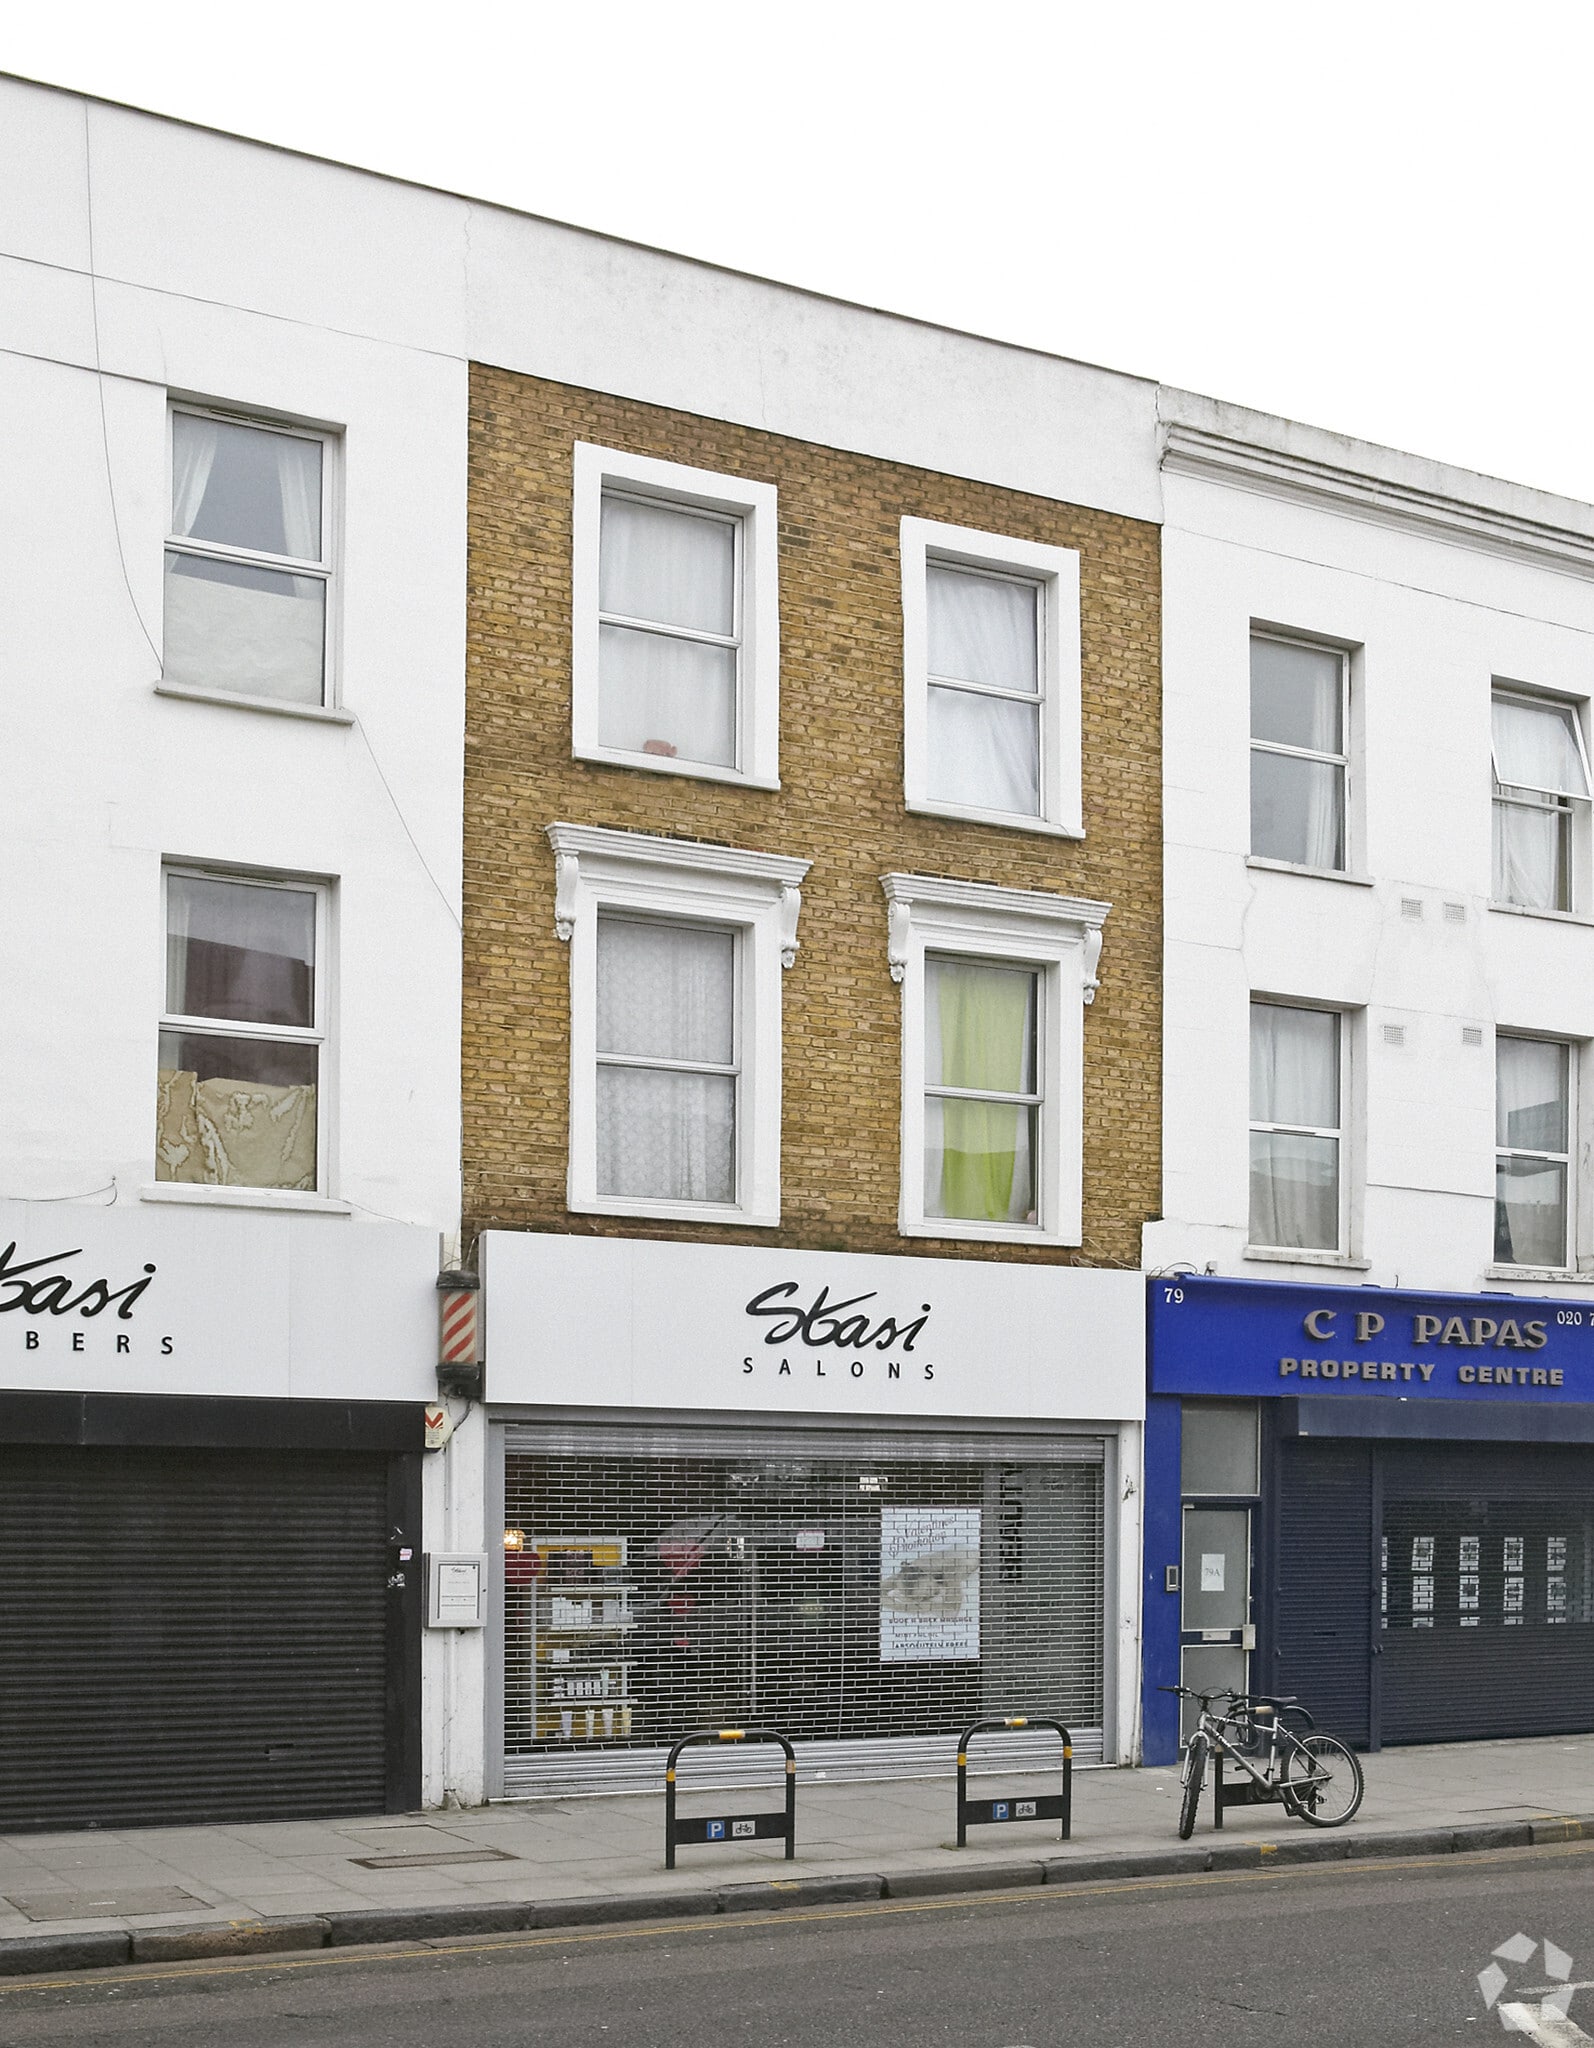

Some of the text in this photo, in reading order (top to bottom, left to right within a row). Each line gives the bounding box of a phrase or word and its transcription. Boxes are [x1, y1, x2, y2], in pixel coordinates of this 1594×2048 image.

[1164, 1287, 1184, 1304] 79
[744, 1281, 932, 1352] Stasi
[1556, 1310, 1583, 1326] 020
[1303, 1309, 1548, 1350] C P PAPAS
[742, 1356, 934, 1381] SALONS
[1279, 1357, 1565, 1386] PROPERTY CENTRE
[1204, 1567, 1221, 1577] 79A
[997, 1804, 1007, 1819] P
[711, 1823, 723, 1838] P
